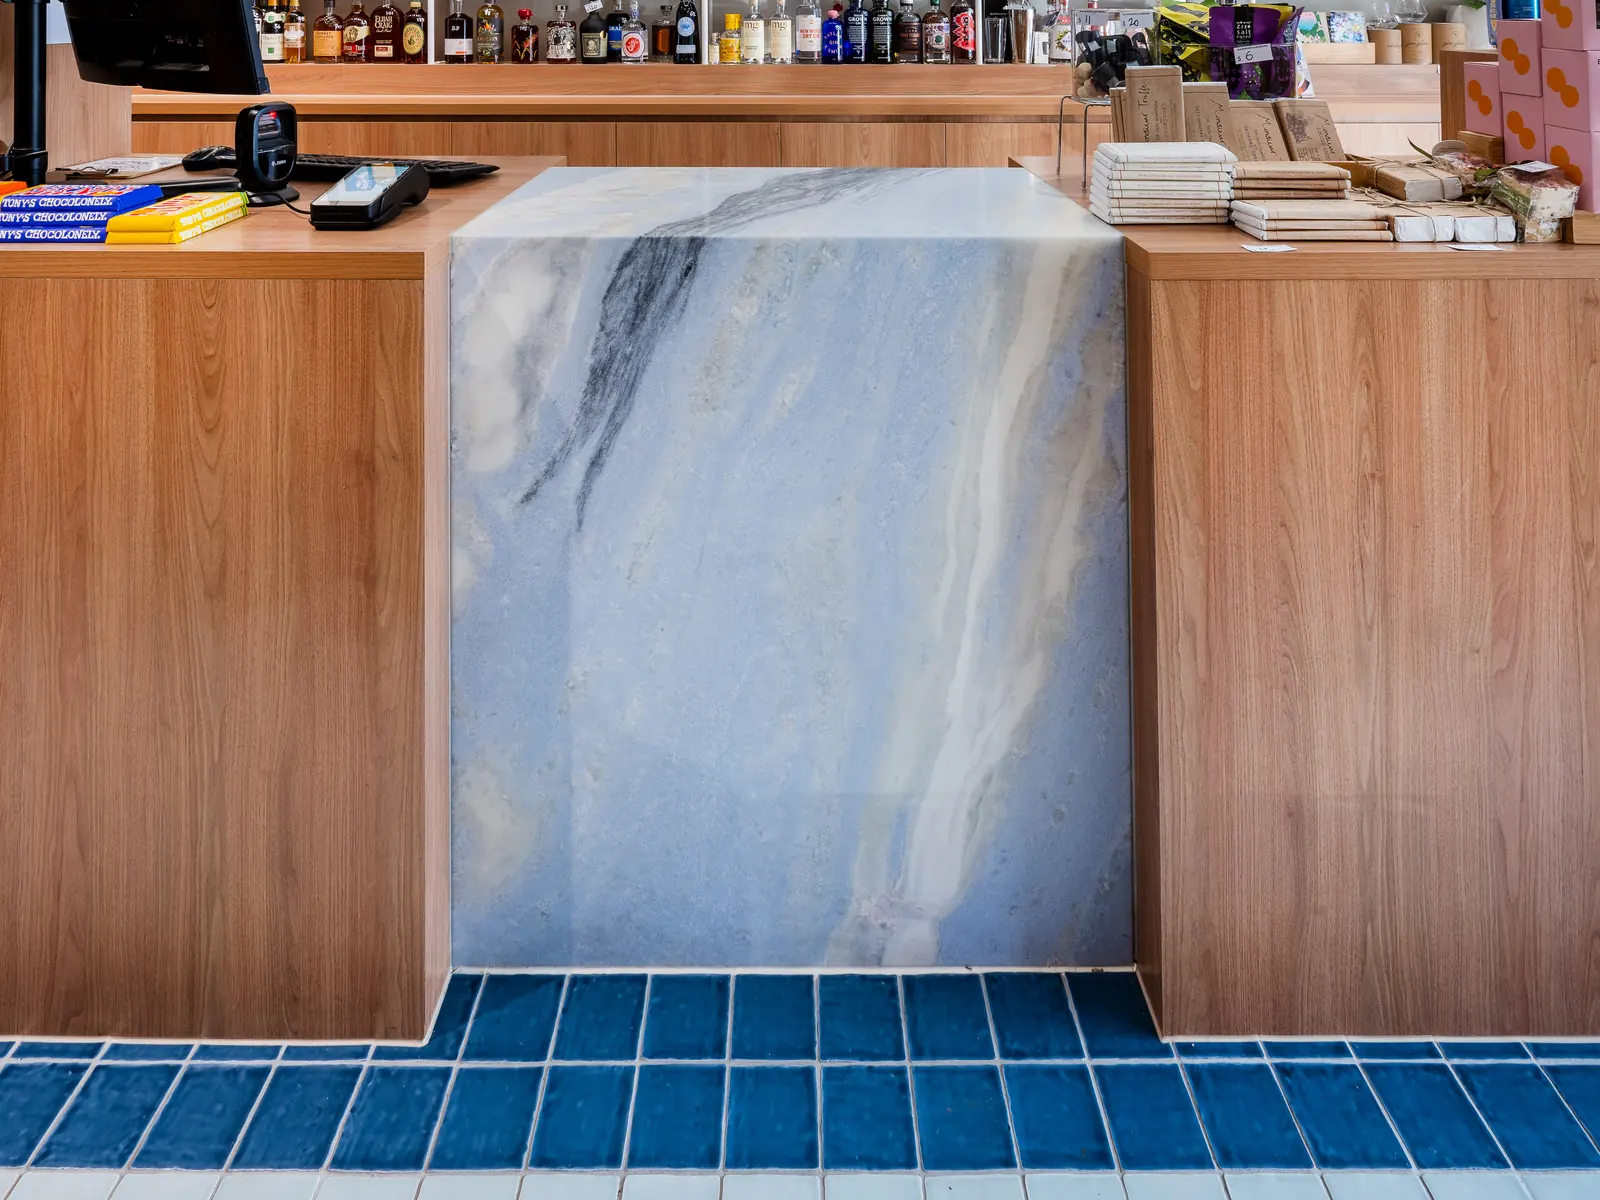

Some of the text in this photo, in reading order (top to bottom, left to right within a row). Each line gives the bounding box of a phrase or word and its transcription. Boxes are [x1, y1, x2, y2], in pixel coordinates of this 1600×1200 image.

[1128, 18, 1139, 26] 20
[1245, 51, 1253, 61] 6
[3, 197, 113, 208] TONY'S CHOCOLONELY.
[33, 212, 108, 221] CHOCOLONELY.
[0, 229, 101, 239] NY'S CHOCOLONELY.
